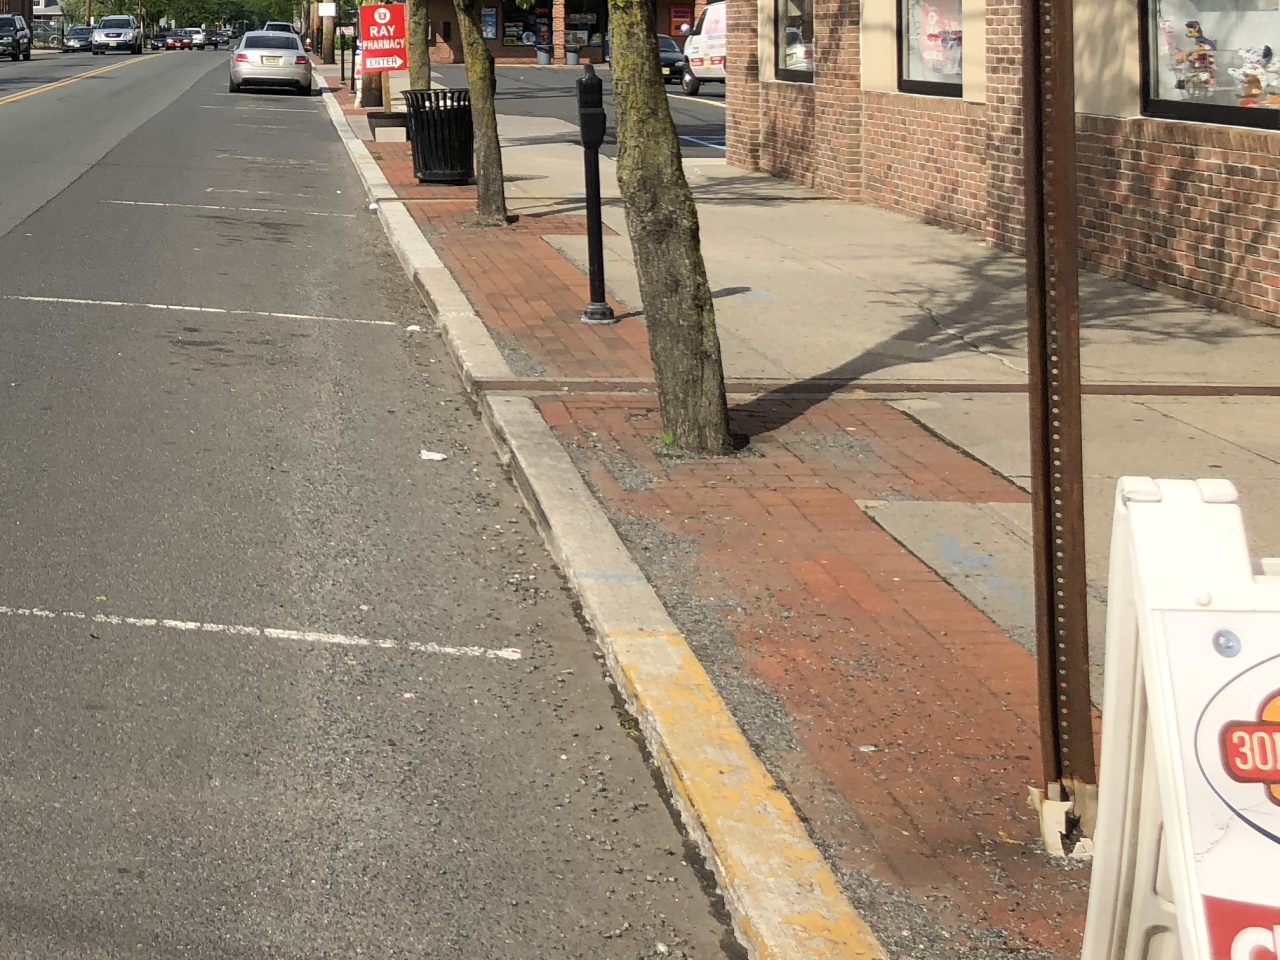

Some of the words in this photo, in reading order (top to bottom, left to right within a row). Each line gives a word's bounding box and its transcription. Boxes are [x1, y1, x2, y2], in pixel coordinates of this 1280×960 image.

[370, 25, 396, 37] RAY
[362, 38, 405, 50] PHARMACY
[369, 57, 397, 67] ENTER
